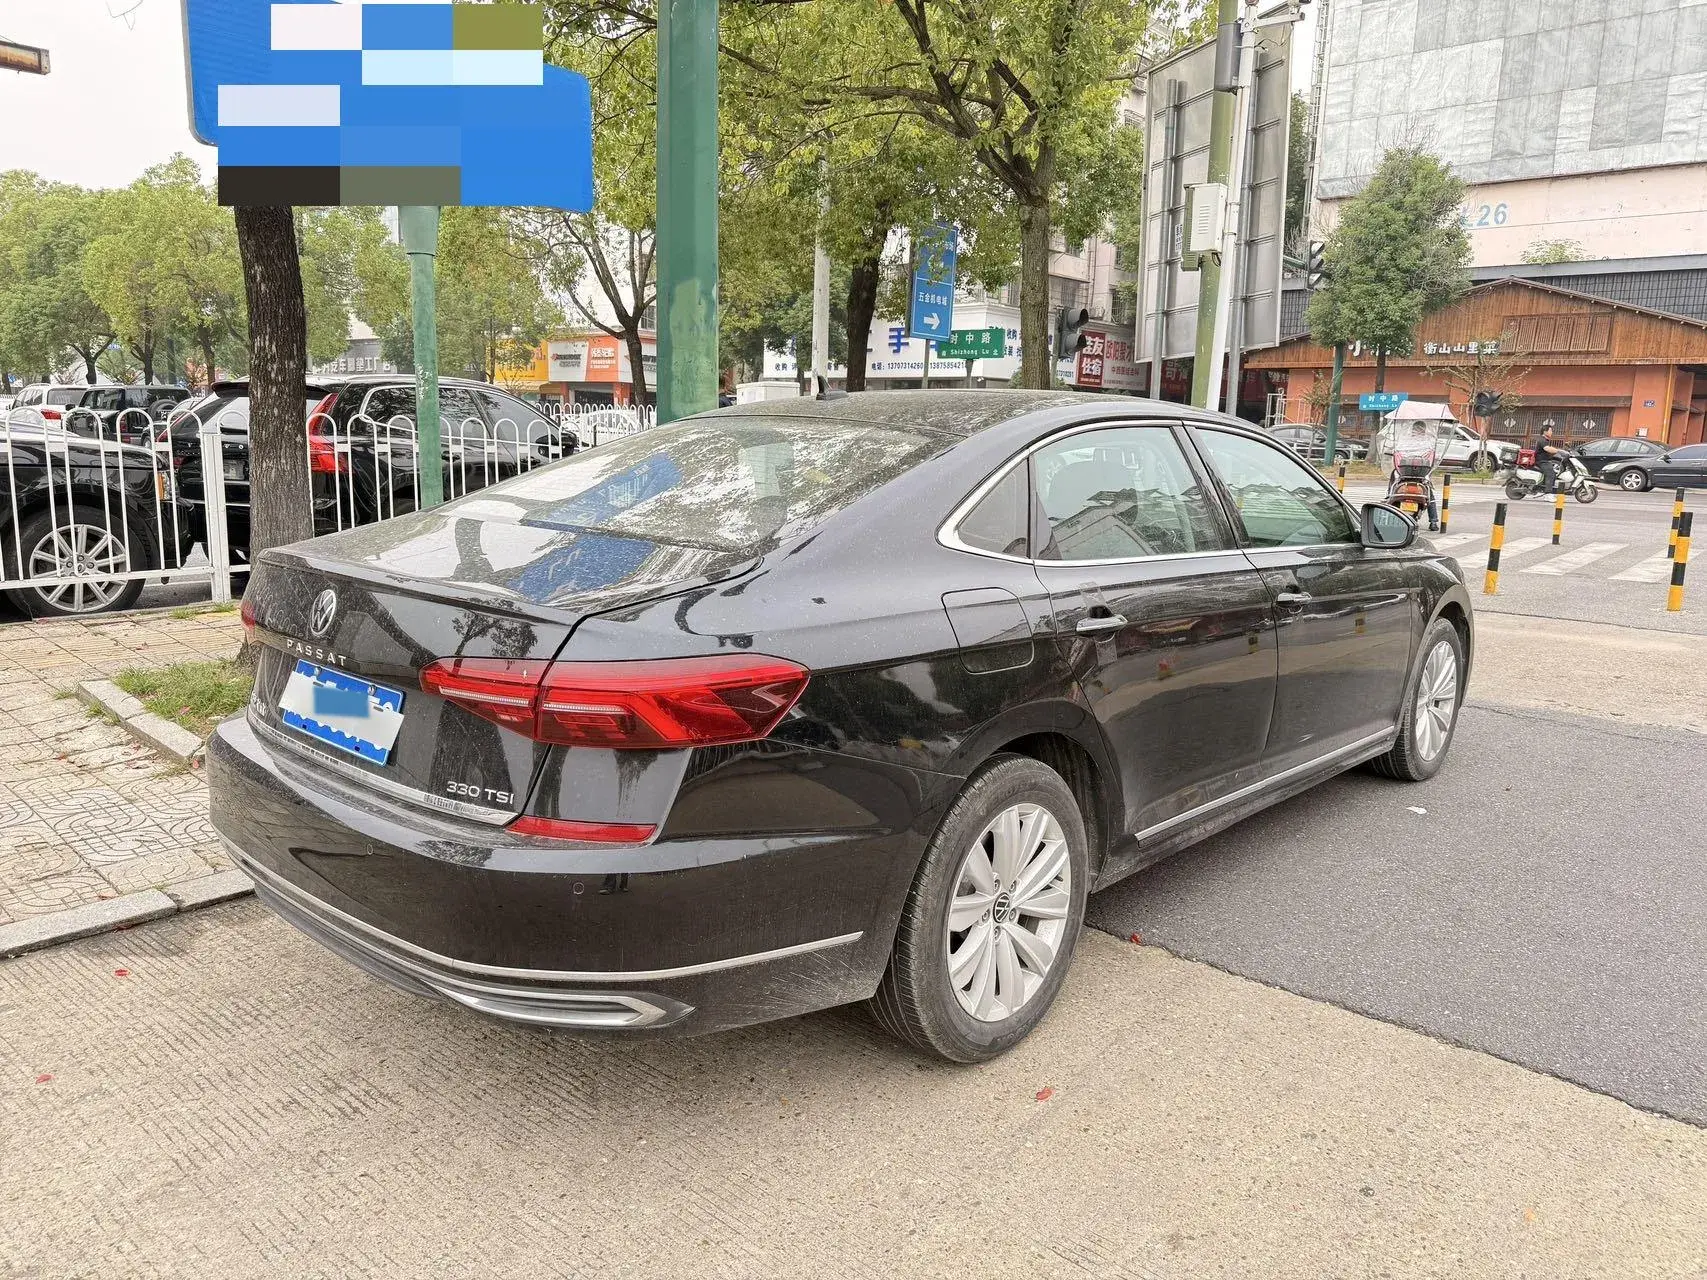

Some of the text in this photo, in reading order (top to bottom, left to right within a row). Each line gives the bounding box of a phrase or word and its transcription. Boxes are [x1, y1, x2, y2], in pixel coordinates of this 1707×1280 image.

[919, 292, 948, 306] 五金机电城
[930, 361, 966, 370] 1387585421
[286, 639, 347, 666] PASSAT
[446, 780, 515, 805] 330 TSI
